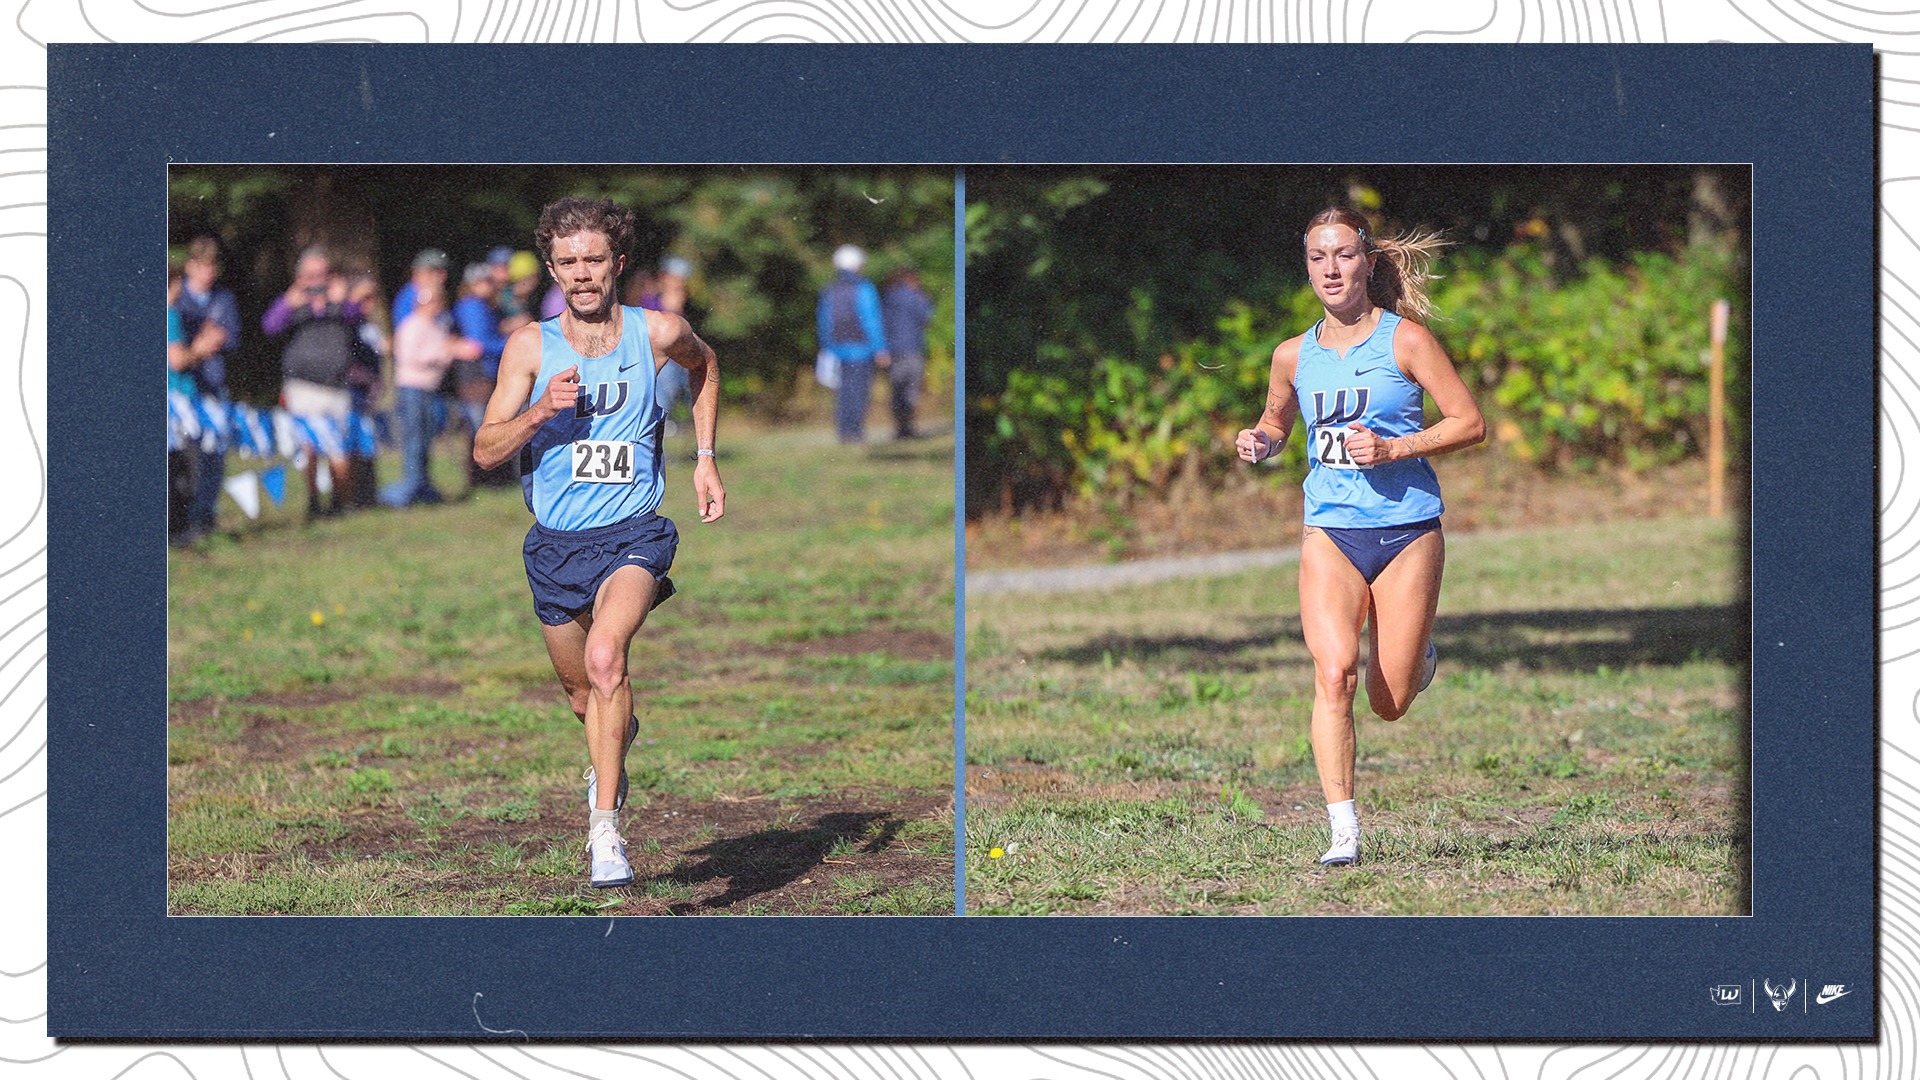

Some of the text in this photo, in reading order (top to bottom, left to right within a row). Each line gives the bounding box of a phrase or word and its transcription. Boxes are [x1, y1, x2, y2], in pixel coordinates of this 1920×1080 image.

[1311, 387, 1370, 426] W
[575, 444, 630, 479] 234
[1320, 430, 1366, 466] 21
